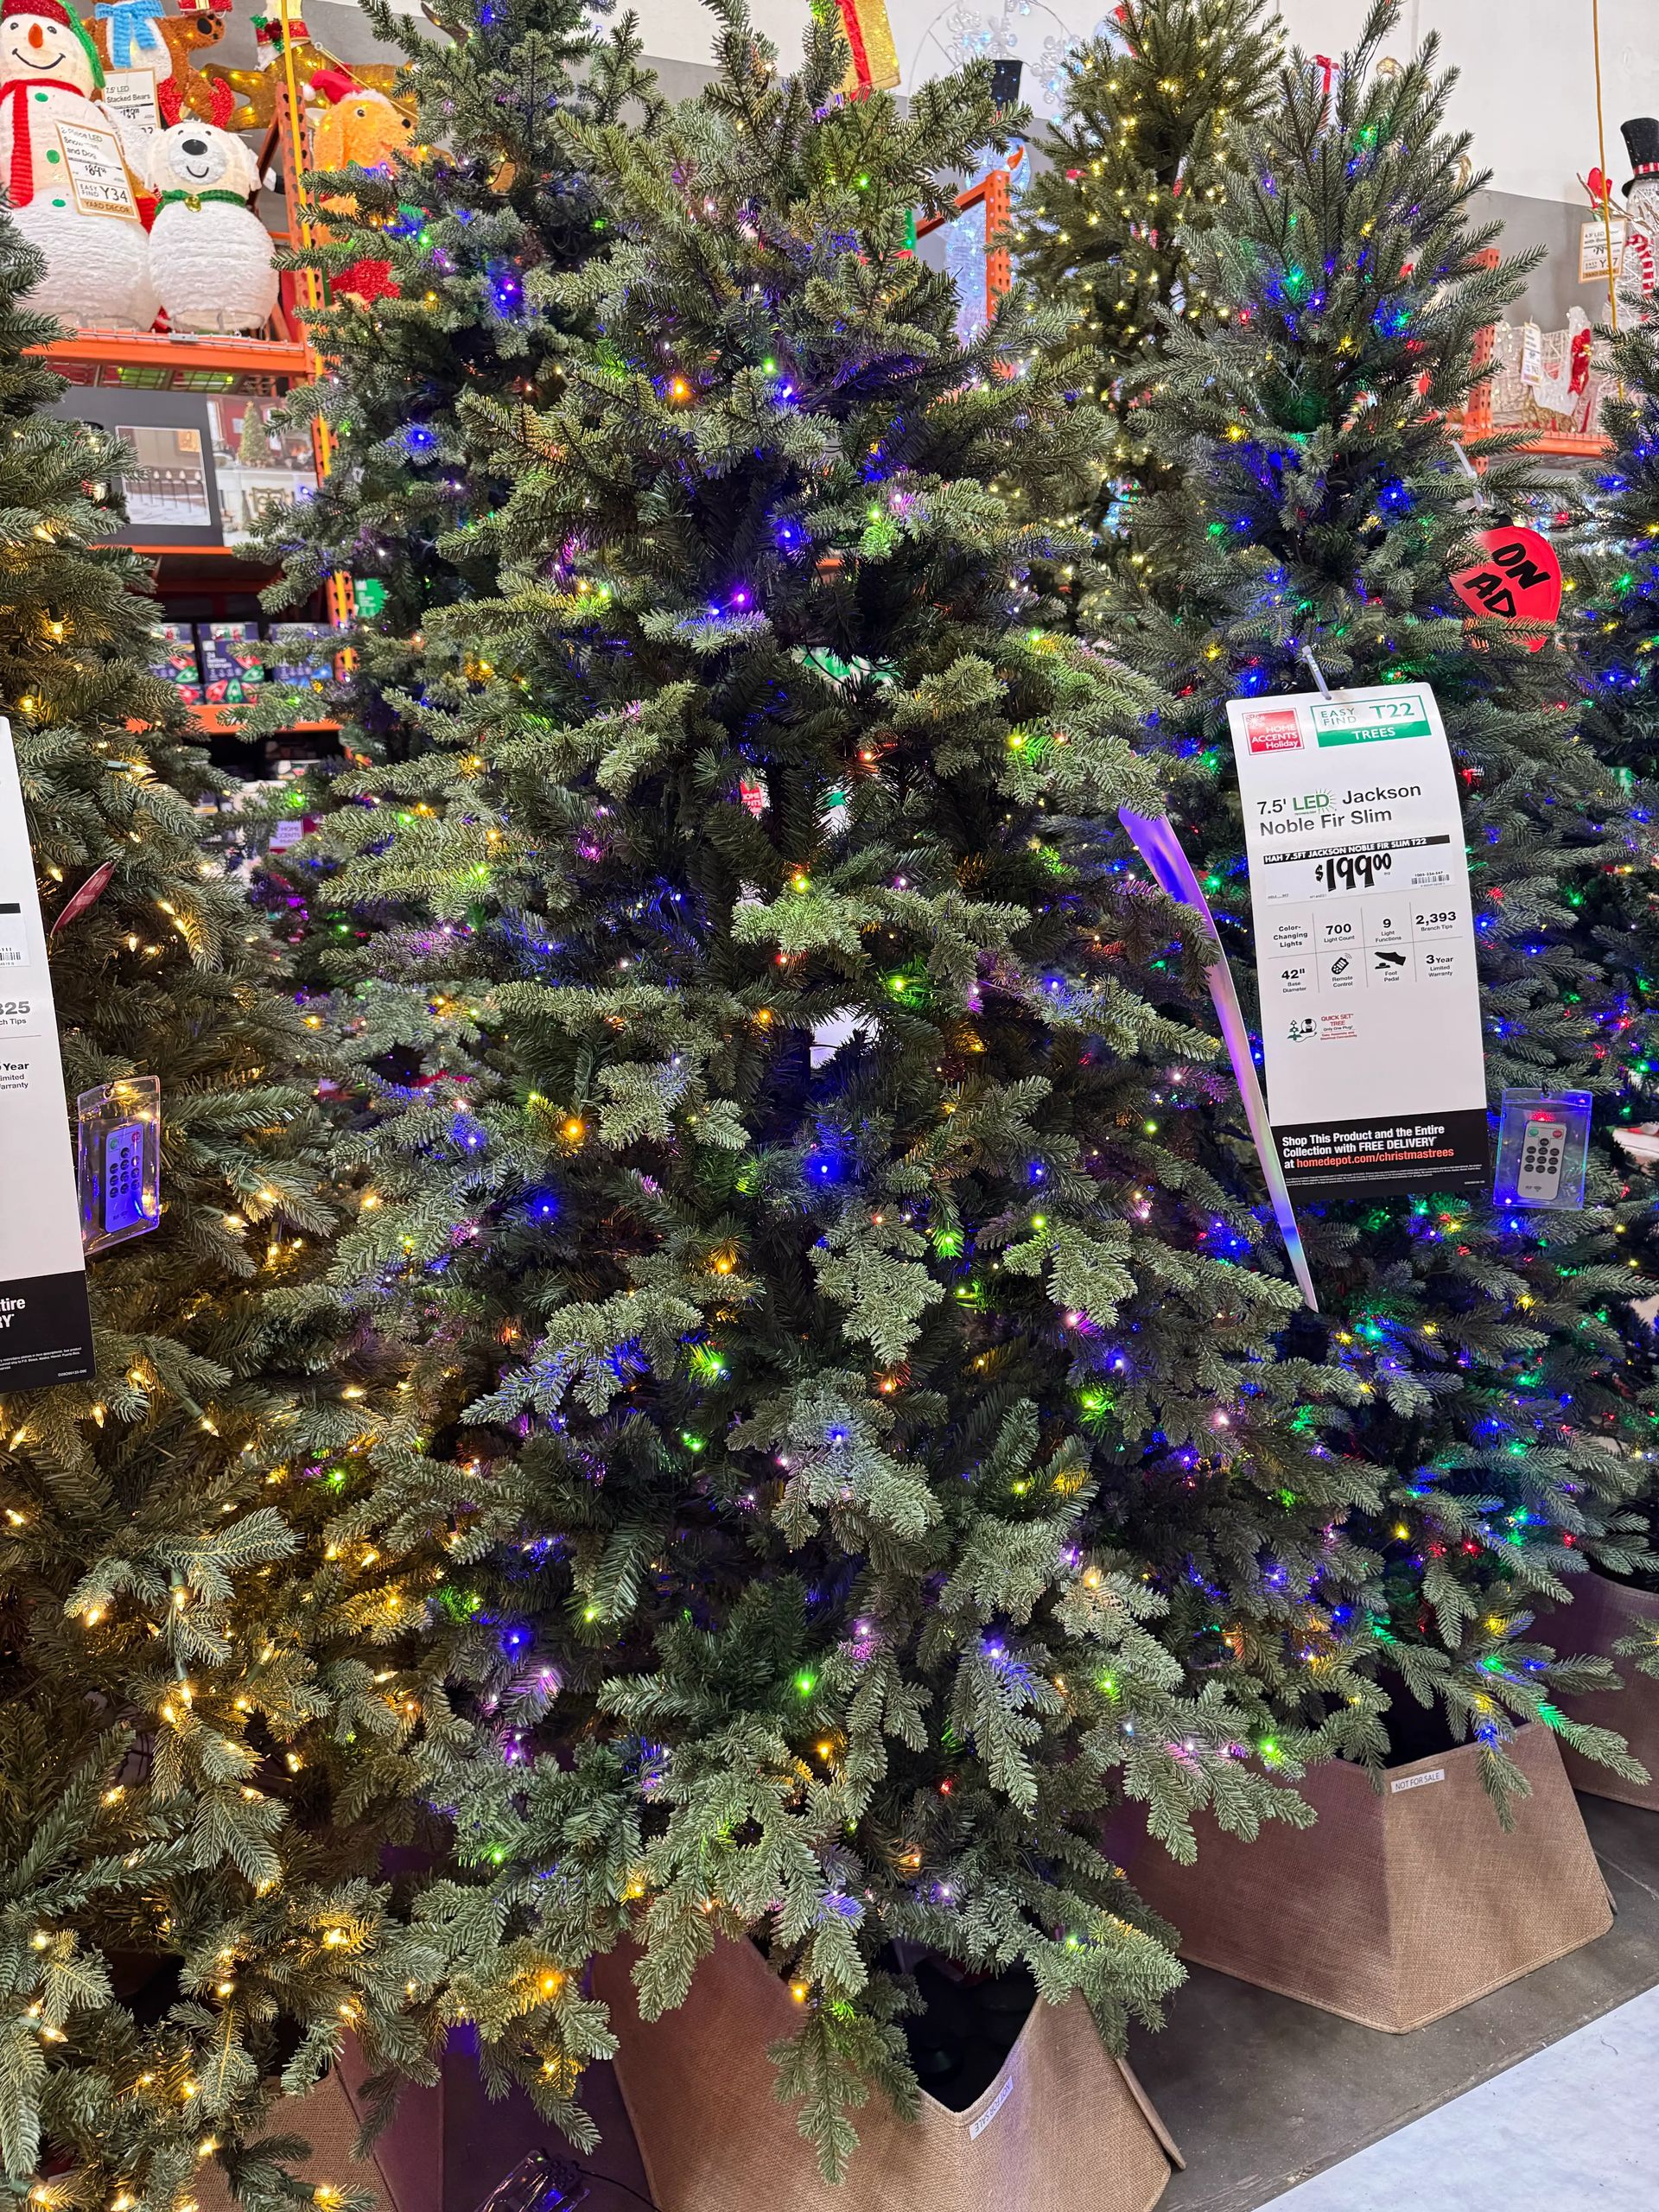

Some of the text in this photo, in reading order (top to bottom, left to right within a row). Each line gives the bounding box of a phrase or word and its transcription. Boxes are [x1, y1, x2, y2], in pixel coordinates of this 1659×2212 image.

[100, 186, 128, 203] Y34
[1491, 543, 1551, 590] ON
[1463, 572, 1516, 619] AD
[1321, 702, 1415, 720] EASY T22
[1324, 715, 1357, 726] FIND
[1266, 724, 1296, 733] HOME
[1351, 728, 1396, 741] TREES
[1252, 732, 1298, 743] ACCENTS
[1266, 741, 1299, 750] Holiday
[1256, 785, 1421, 815] 7.5' LED Jackson
[1260, 809, 1392, 836] Noble Fir Slim
[1264, 855, 1283, 863] HAH
[1307, 847, 1347, 858] JACKSON
[1348, 843, 1376, 853] NOBLE
[1390, 839, 1410, 848] SLIM
[1411, 837, 1427, 846] T22
[1382, 918, 1392, 928] 9
[1415, 911, 1457, 926] 2,393
[1273, 932, 1308, 941] Changing
[1325, 923, 1351, 935] 700
[1426, 955, 1435, 964] 3
[3, 1063, 29, 1071] Year
[0, 1073, 25, 1082] imited
[1282, 1124, 1445, 1147] Shop This Product and the Entire
[1283, 1145, 1332, 1158] Collection
[1334, 1143, 1356, 1154] with
[1358, 1141, 1384, 1152] FREE
[1284, 1148, 1454, 1169] at homedepot.com/christmastrees
[0, 1298, 26, 1312] tire
[1395, 1772, 1440, 1790] NOT FOR SALE
[974, 2113, 990, 2133] SALE
